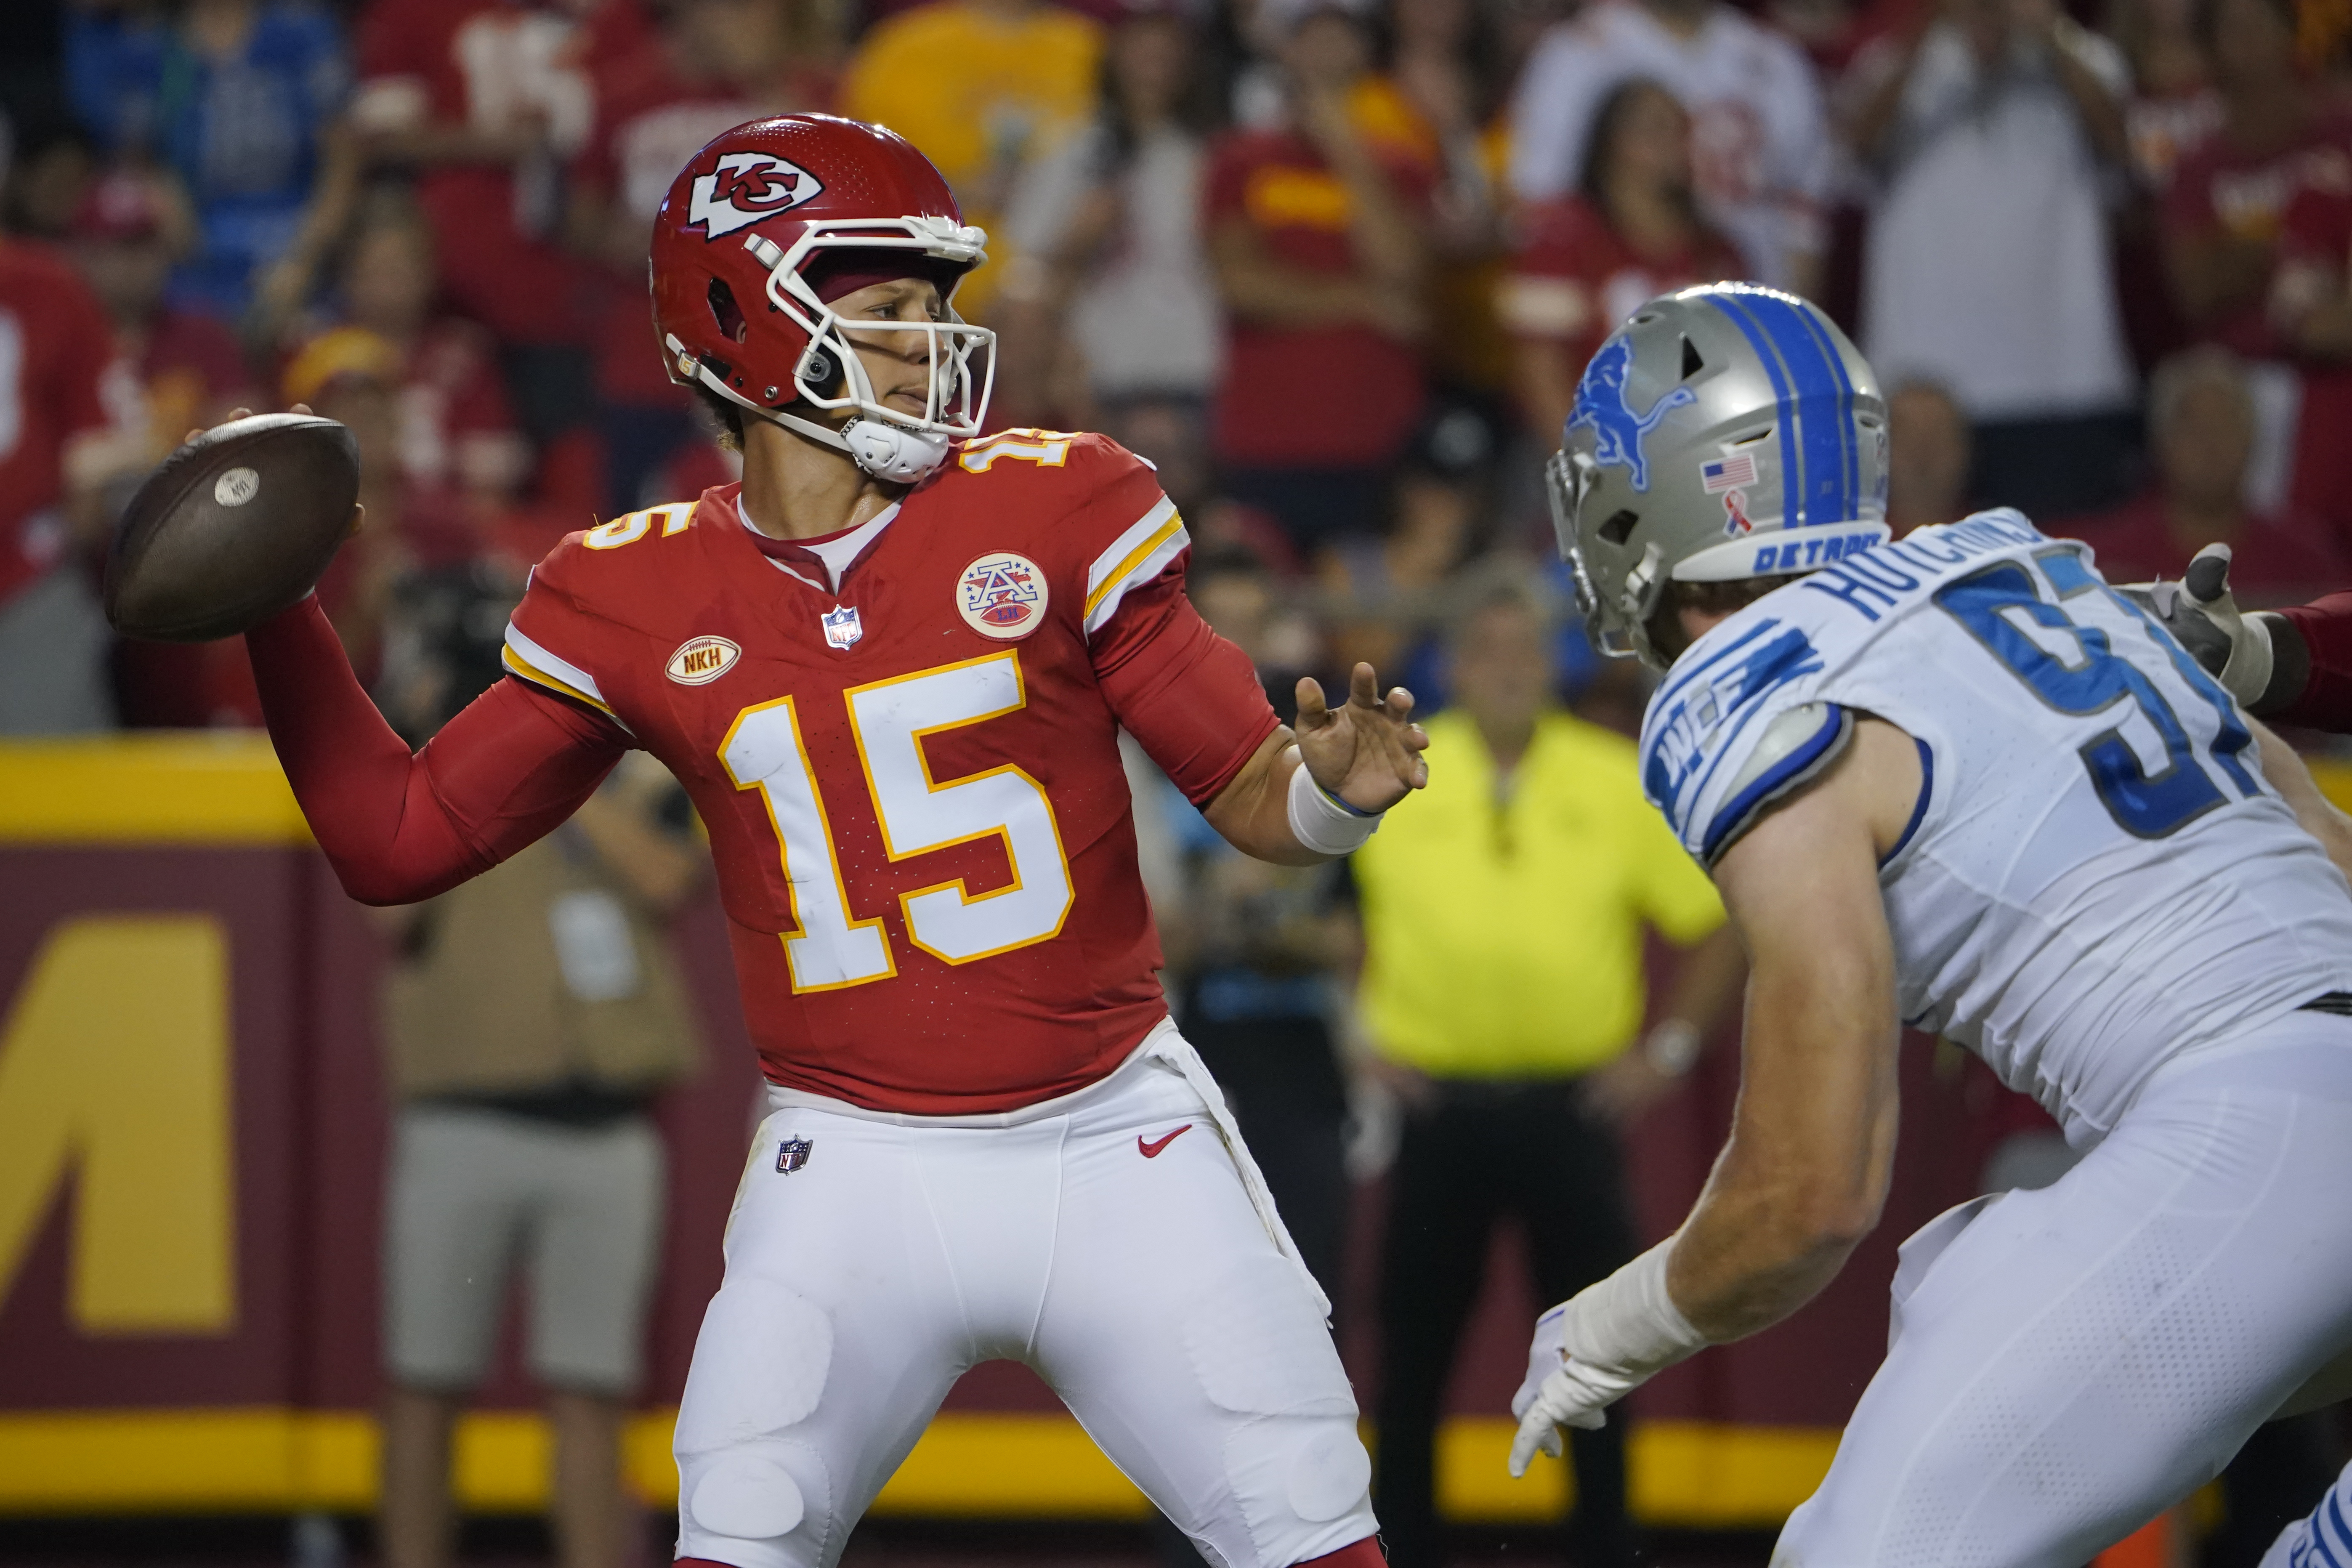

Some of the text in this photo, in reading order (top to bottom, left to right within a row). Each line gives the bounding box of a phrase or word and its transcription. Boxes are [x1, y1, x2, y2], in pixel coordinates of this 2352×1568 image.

[710, 162, 799, 212] KC
[996, 607, 1019, 621] LH
[831, 622, 856, 641] NFL
[683, 647, 722, 675] NKH
[717, 648, 1076, 994] 15
